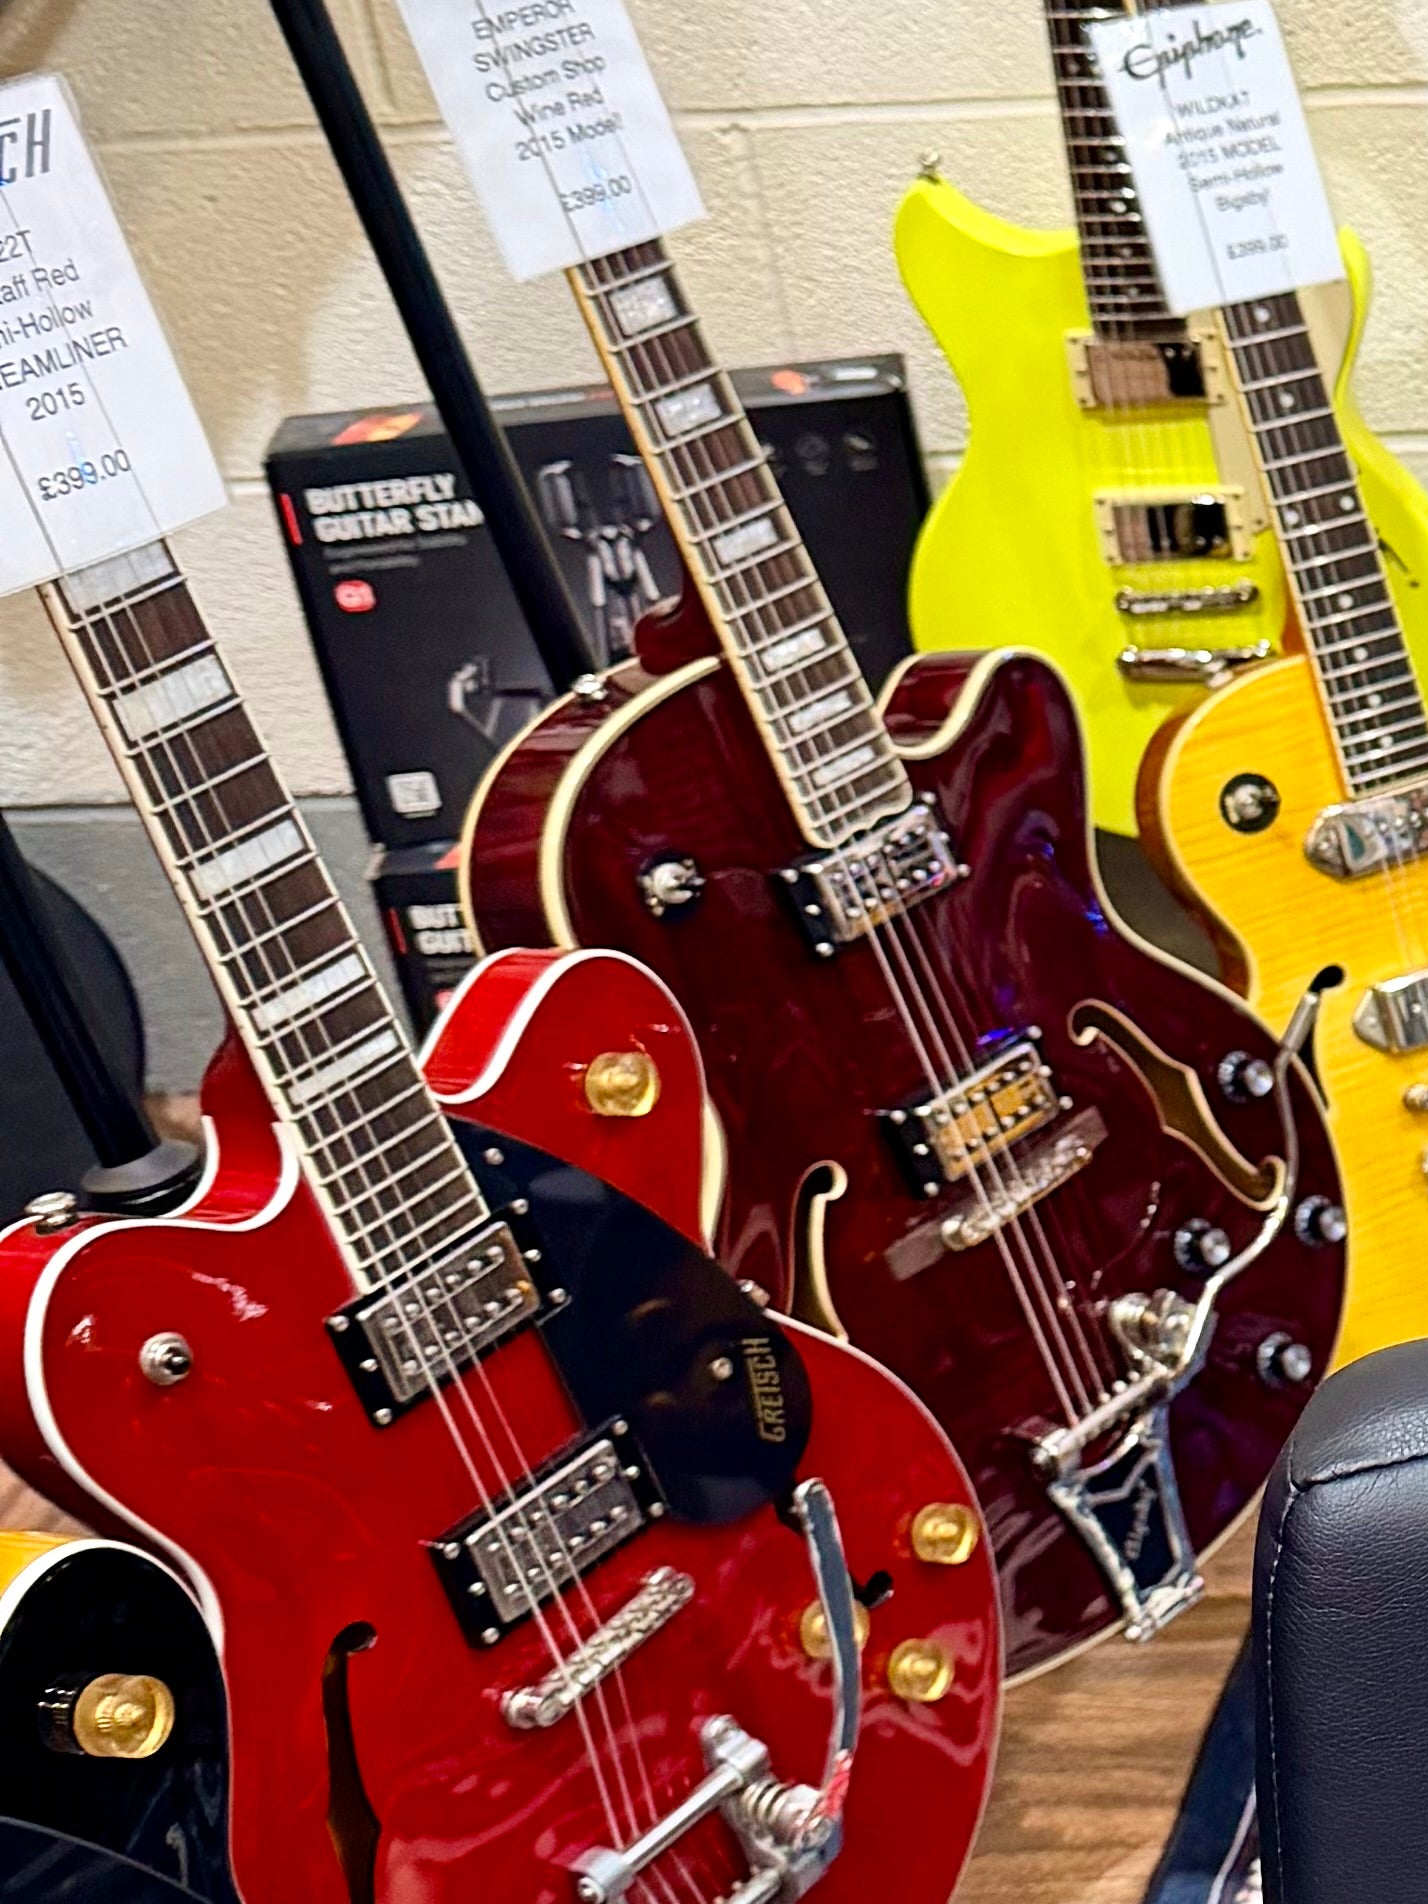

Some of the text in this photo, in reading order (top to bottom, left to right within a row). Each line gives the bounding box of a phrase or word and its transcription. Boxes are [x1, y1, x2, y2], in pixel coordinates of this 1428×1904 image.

[472, 22, 597, 74] SWINGSTER
[484, 54, 608, 104] Custom Shop
[513, 87, 606, 128] Wine Red
[513, 132, 568, 163] 2015
[0, 256, 81, 306] aff Red
[0, 325, 129, 392] EAMLINER
[25, 382, 87, 423] 2015
[36, 448, 133, 502] £399.00
[304, 472, 459, 516] BUTTERFLY
[314, 505, 414, 544] GUITAR
[743, 1335, 786, 1446] GRETSCH
